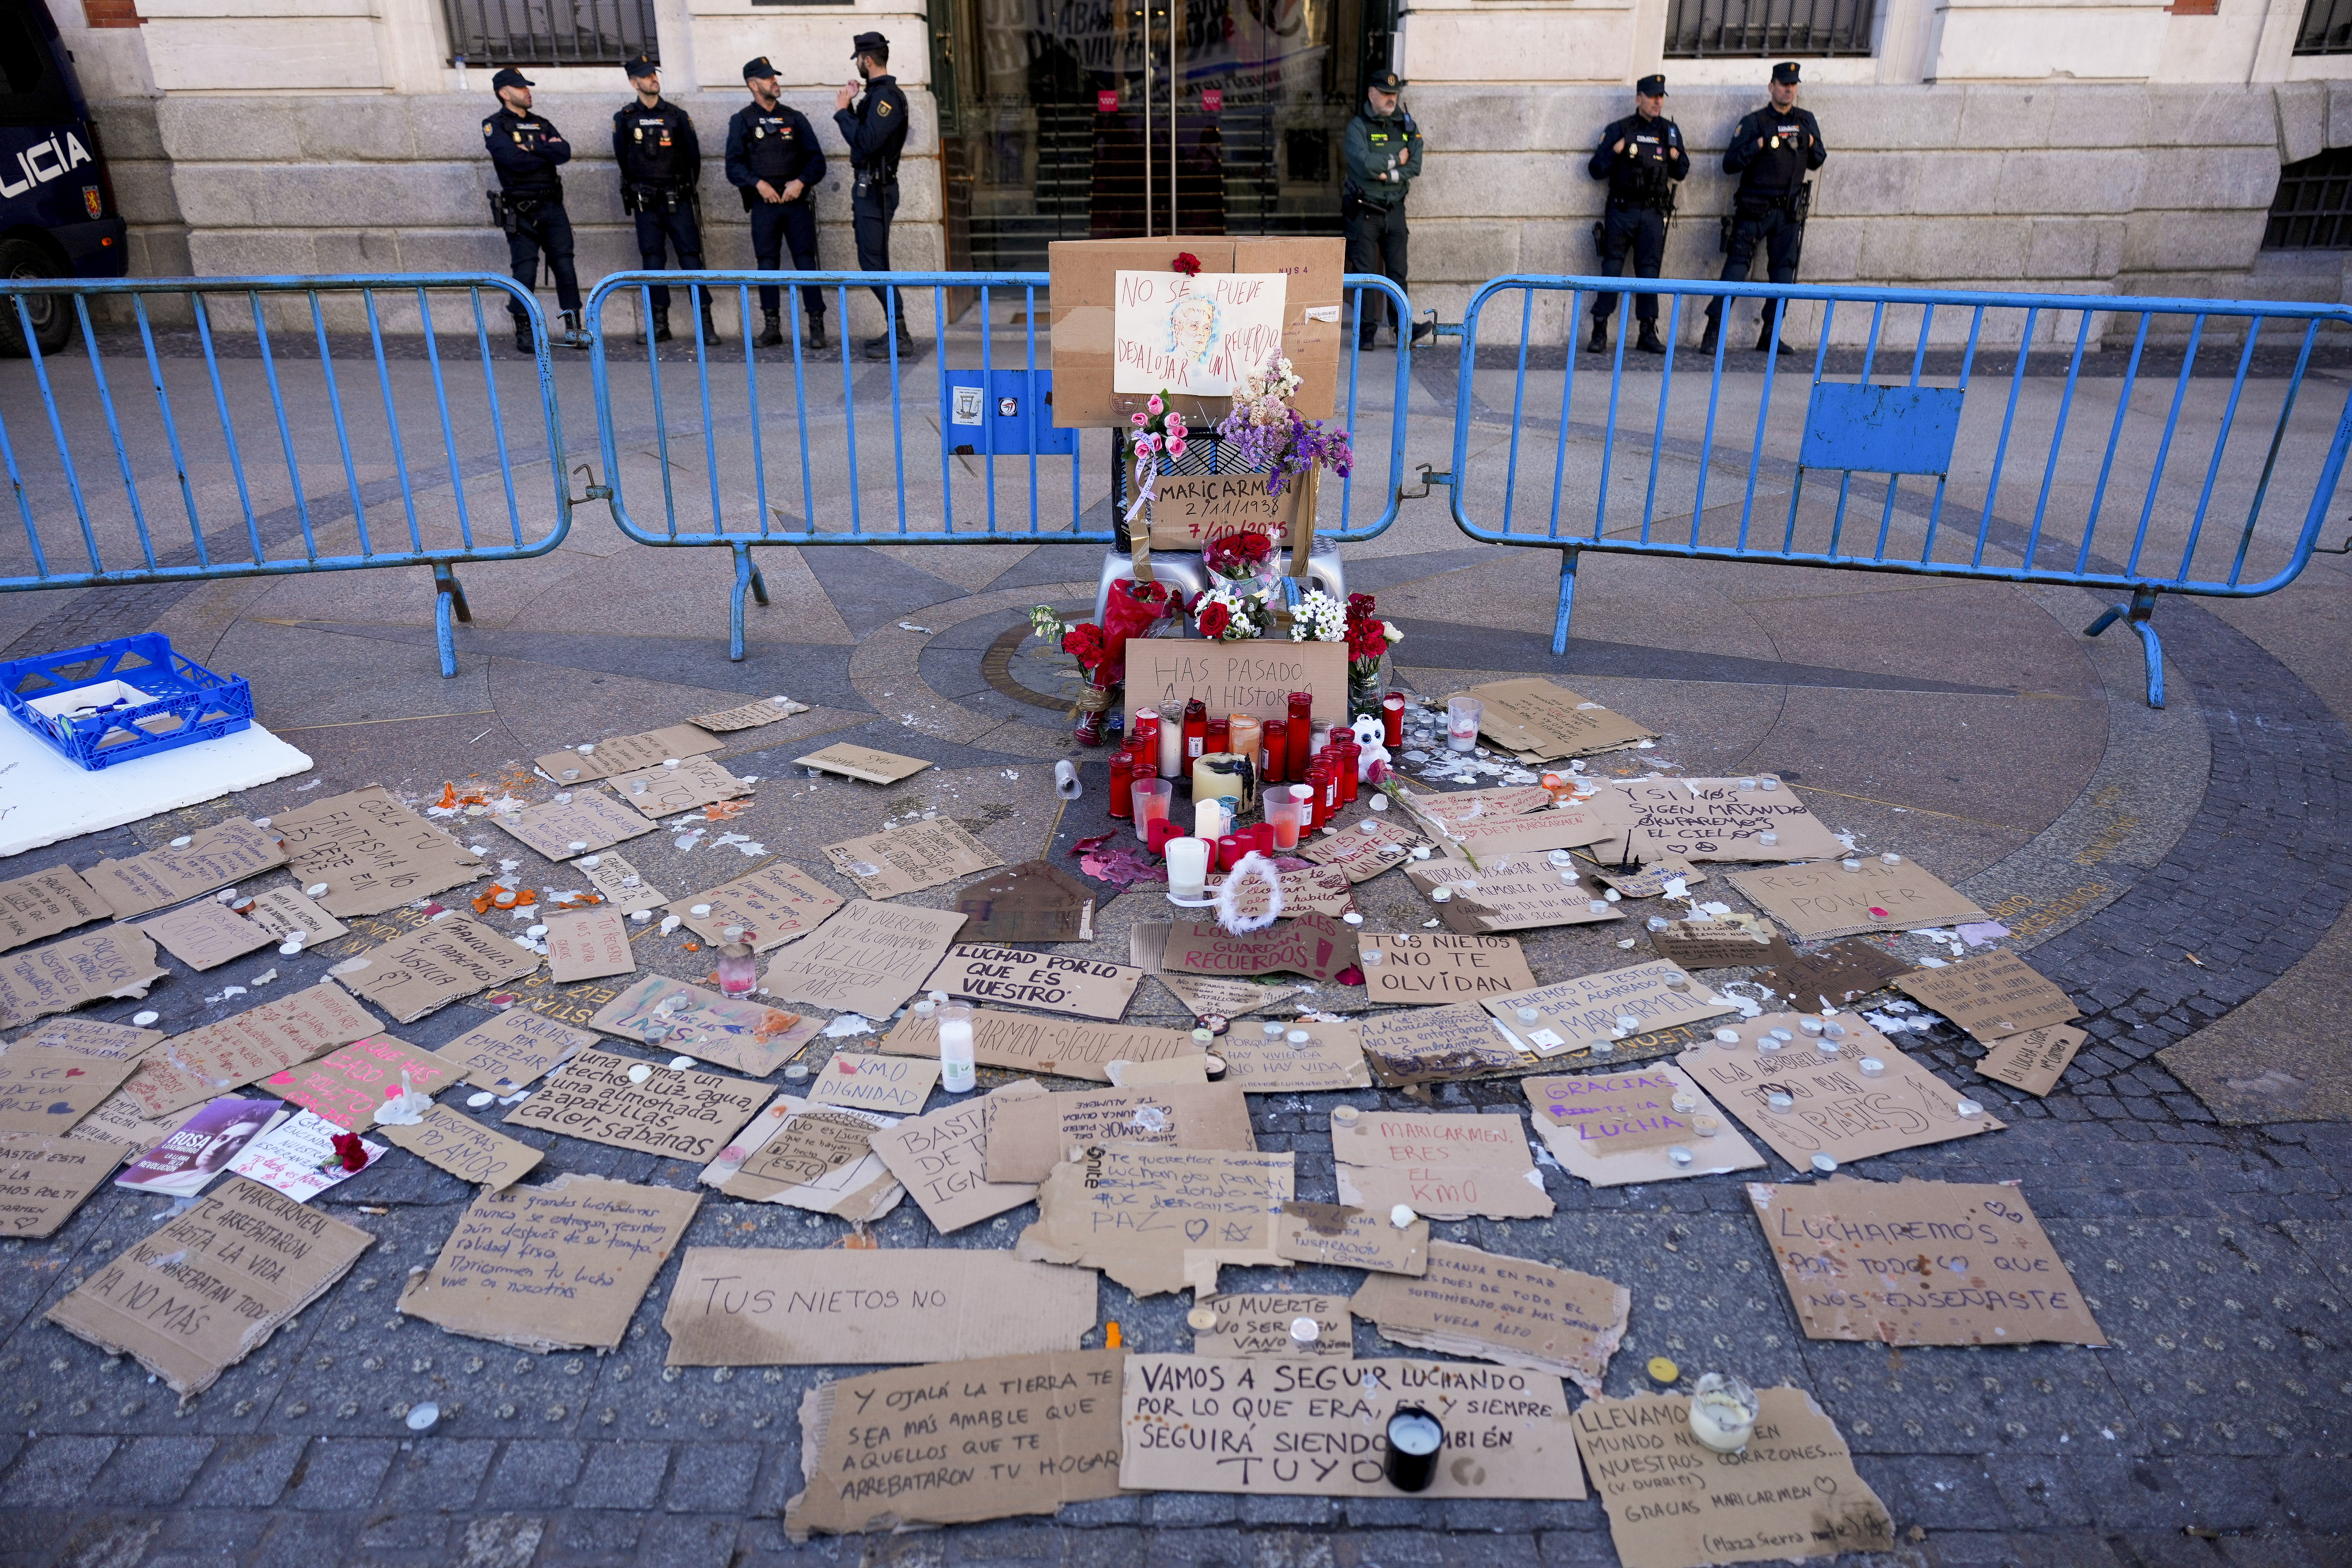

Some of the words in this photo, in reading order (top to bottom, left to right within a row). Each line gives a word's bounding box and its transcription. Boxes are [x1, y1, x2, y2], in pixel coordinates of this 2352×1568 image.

[1122, 277, 1153, 307] NO
[1165, 280, 1191, 304] SE
[1215, 279, 1265, 305] PUEDE
[1118, 338, 1188, 387] DESALOJAR
[1209, 356, 1224, 377] UN
[1154, 657, 1209, 687] HAS
[1228, 658, 1303, 682] PASADO
[1163, 682, 1176, 701] A
[1224, 682, 1315, 708] HISTORA
[1615, 787, 1638, 801] Y
[1647, 789, 1678, 801] SI
[1629, 803, 1694, 814] SIGEN
[311, 811, 408, 870] FANTASMA
[390, 872, 421, 888] NO
[411, 832, 446, 849] TU
[307, 841, 354, 868] DEJE
[351, 873, 378, 892] EN
[1759, 871, 1843, 890] REST
[1865, 864, 1896, 878] IN
[1791, 888, 1926, 918] POWER
[842, 904, 867, 921] NO
[867, 909, 941, 935] QUEREMOS
[440, 917, 508, 970] TRANQUILA,
[1212, 931, 1300, 955] GUARDAN
[1364, 934, 1423, 950] TUS
[1432, 934, 1512, 949] NIETOS
[390, 946, 458, 986] JUSTICIA
[434, 943, 498, 982] DAREMOS
[1047, 956, 1088, 974] POR
[1091, 964, 1118, 979] LO
[1390, 951, 1432, 967] NO
[1449, 951, 1490, 968] TE
[1907, 975, 1927, 985] HAS
[1936, 959, 1991, 978] ENCENDIDO
[1994, 953, 2009, 962] UN
[791, 961, 890, 989] INJUSTICIA
[966, 962, 1015, 980] QUE
[1028, 969, 1061, 986] ES
[1380, 970, 1512, 993] OLVIDAN
[1496, 984, 1578, 1011] TENEMOS
[1578, 979, 1602, 992] EL
[1603, 965, 1670, 985] TESTIGO
[1921, 980, 1956, 993] FUEGO
[1960, 975, 1969, 984] Y
[1974, 972, 1990, 982] EN
[795, 979, 854, 1000] MAS
[1192, 993, 1250, 1004] BATALLONES
[1539, 998, 1580, 1017] BIEN
[1587, 979, 1659, 1004] AGARRADO
[505, 1014, 575, 1047] GRACIAS
[514, 1033, 536, 1047] POR
[464, 1034, 550, 1072] EMPEZAR
[465, 1054, 508, 1075] ESTO
[2007, 1044, 2037, 1070] LUCHA
[578, 1051, 622, 1069] una
[693, 1072, 724, 1088] un
[1999, 1064, 2024, 1083] LA
[820, 1080, 918, 1106] DIGNIDAD
[1544, 1070, 1680, 1101] GRACIAS
[537, 1090, 679, 1131] zapatillas,
[550, 1077, 593, 1094] una
[598, 1086, 723, 1124] almohada,
[694, 1088, 752, 1113] agua,
[167, 1131, 212, 1149] ROSA
[519, 1104, 593, 1133] calor,
[596, 1120, 714, 1157] sábanas
[1578, 1114, 1686, 1141] LUCHA
[161, 1143, 200, 1154] LUXEMBURGO
[1389, 1145, 1450, 1162] ERES
[138, 1160, 179, 1172] REVOLUCIÓN
[427, 1144, 508, 1184] AMOR
[1408, 1167, 1442, 1183] EL
[227, 1181, 329, 1239] MARICARMEN,
[1091, 1210, 1175, 1233] PAZ
[217, 1209, 313, 1260] ARREBATARON
[1781, 1208, 1999, 1245] LUCHAREMOS
[216, 1242, 238, 1264] LA
[1789, 1252, 1841, 1274] POR
[1861, 1257, 1924, 1276] TODO
[1994, 1256, 2051, 1274] QUE
[91, 1266, 118, 1297] YA
[117, 1281, 159, 1310] NO
[147, 1297, 211, 1336] MÁS
[701, 1275, 776, 1316] TUS
[787, 1286, 900, 1315] NIETOS
[911, 1289, 946, 1310] NO
[1810, 1292, 1867, 1310] NOS
[1141, 1363, 1225, 1393] VAMOS
[1236, 1367, 1256, 1389] A
[1274, 1364, 1393, 1393] SEGUIR
[1401, 1366, 1527, 1391] LUCHANDO
[854, 1388, 876, 1416] Y
[885, 1381, 950, 1412] OJALÁ
[963, 1383, 988, 1398] LA
[999, 1372, 1078, 1395] TIERRA
[1086, 1370, 1113, 1386] TE
[1137, 1396, 1176, 1417] POR
[1191, 1397, 1220, 1418] LO
[1232, 1396, 1293, 1419] QUE
[1309, 1398, 1383, 1421] ERA,
[1442, 1396, 1458, 1416] Y
[1466, 1398, 1553, 1418] SIEMPRE
[848, 1426, 890, 1449] SEA
[949, 1408, 1029, 1433] AMABLE
[1044, 1398, 1096, 1421] QUE
[1139, 1423, 1254, 1453] SEGUIRÁ
[1273, 1431, 1387, 1455] SIENDO
[841, 1445, 948, 1473] AQUELLOS
[962, 1439, 1003, 1455] QUE
[1011, 1434, 1040, 1450] TE
[840, 1467, 976, 1502] ARREBATARON
[989, 1464, 1020, 1480] TU
[1039, 1449, 1120, 1476] HOGAR
[1217, 1457, 1385, 1485] TUYO
[1624, 1500, 1701, 1524] GRACIAS
